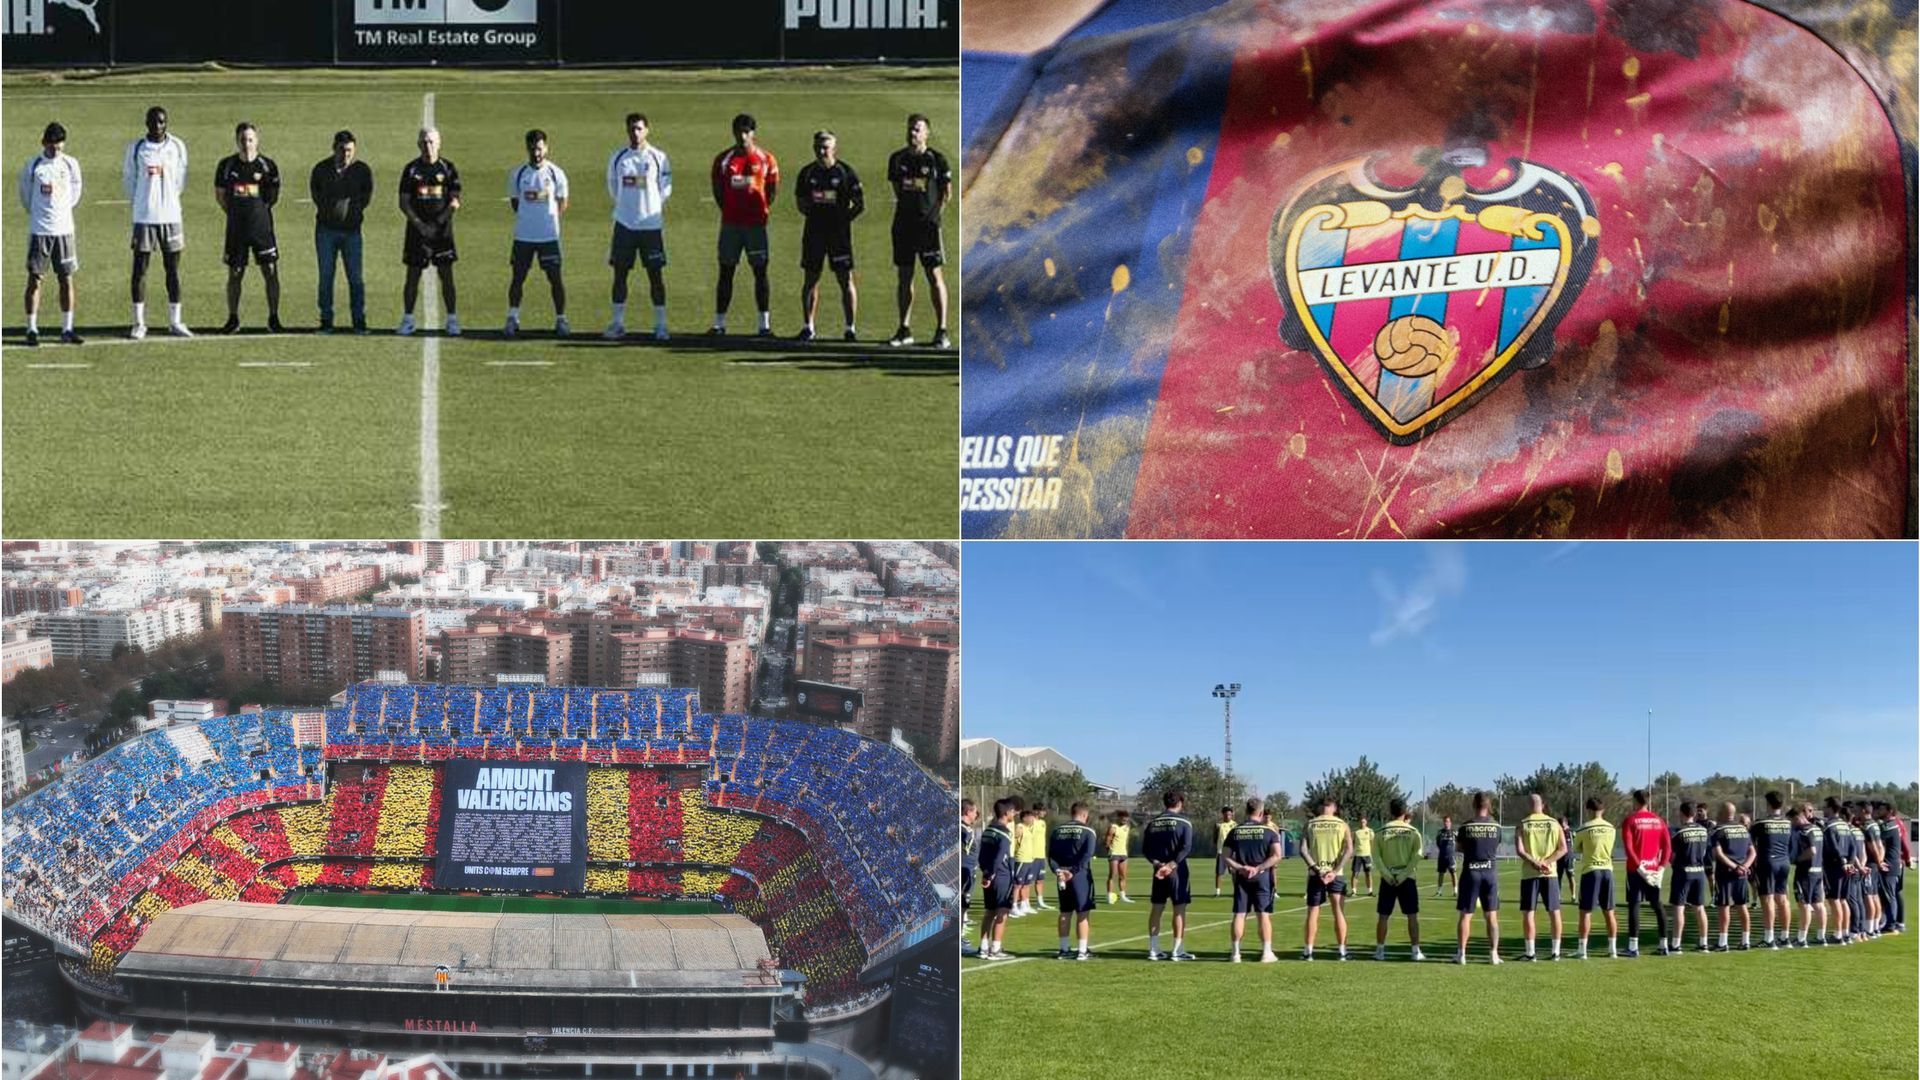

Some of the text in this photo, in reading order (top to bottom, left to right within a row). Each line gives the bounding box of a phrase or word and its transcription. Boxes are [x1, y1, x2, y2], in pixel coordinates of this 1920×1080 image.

[355, 30, 537, 47] TM Real Estate Group
[1320, 256, 1537, 298] LEVANTE U.D.
[1013, 435, 1064, 473] QUE
[475, 767, 555, 792] AMUNT
[457, 789, 573, 812] VALENCIANS
[464, 866, 484, 875] UNITS
[502, 867, 529, 876] SEMPRE
[551, 1027, 581, 1035] VALENCIA
